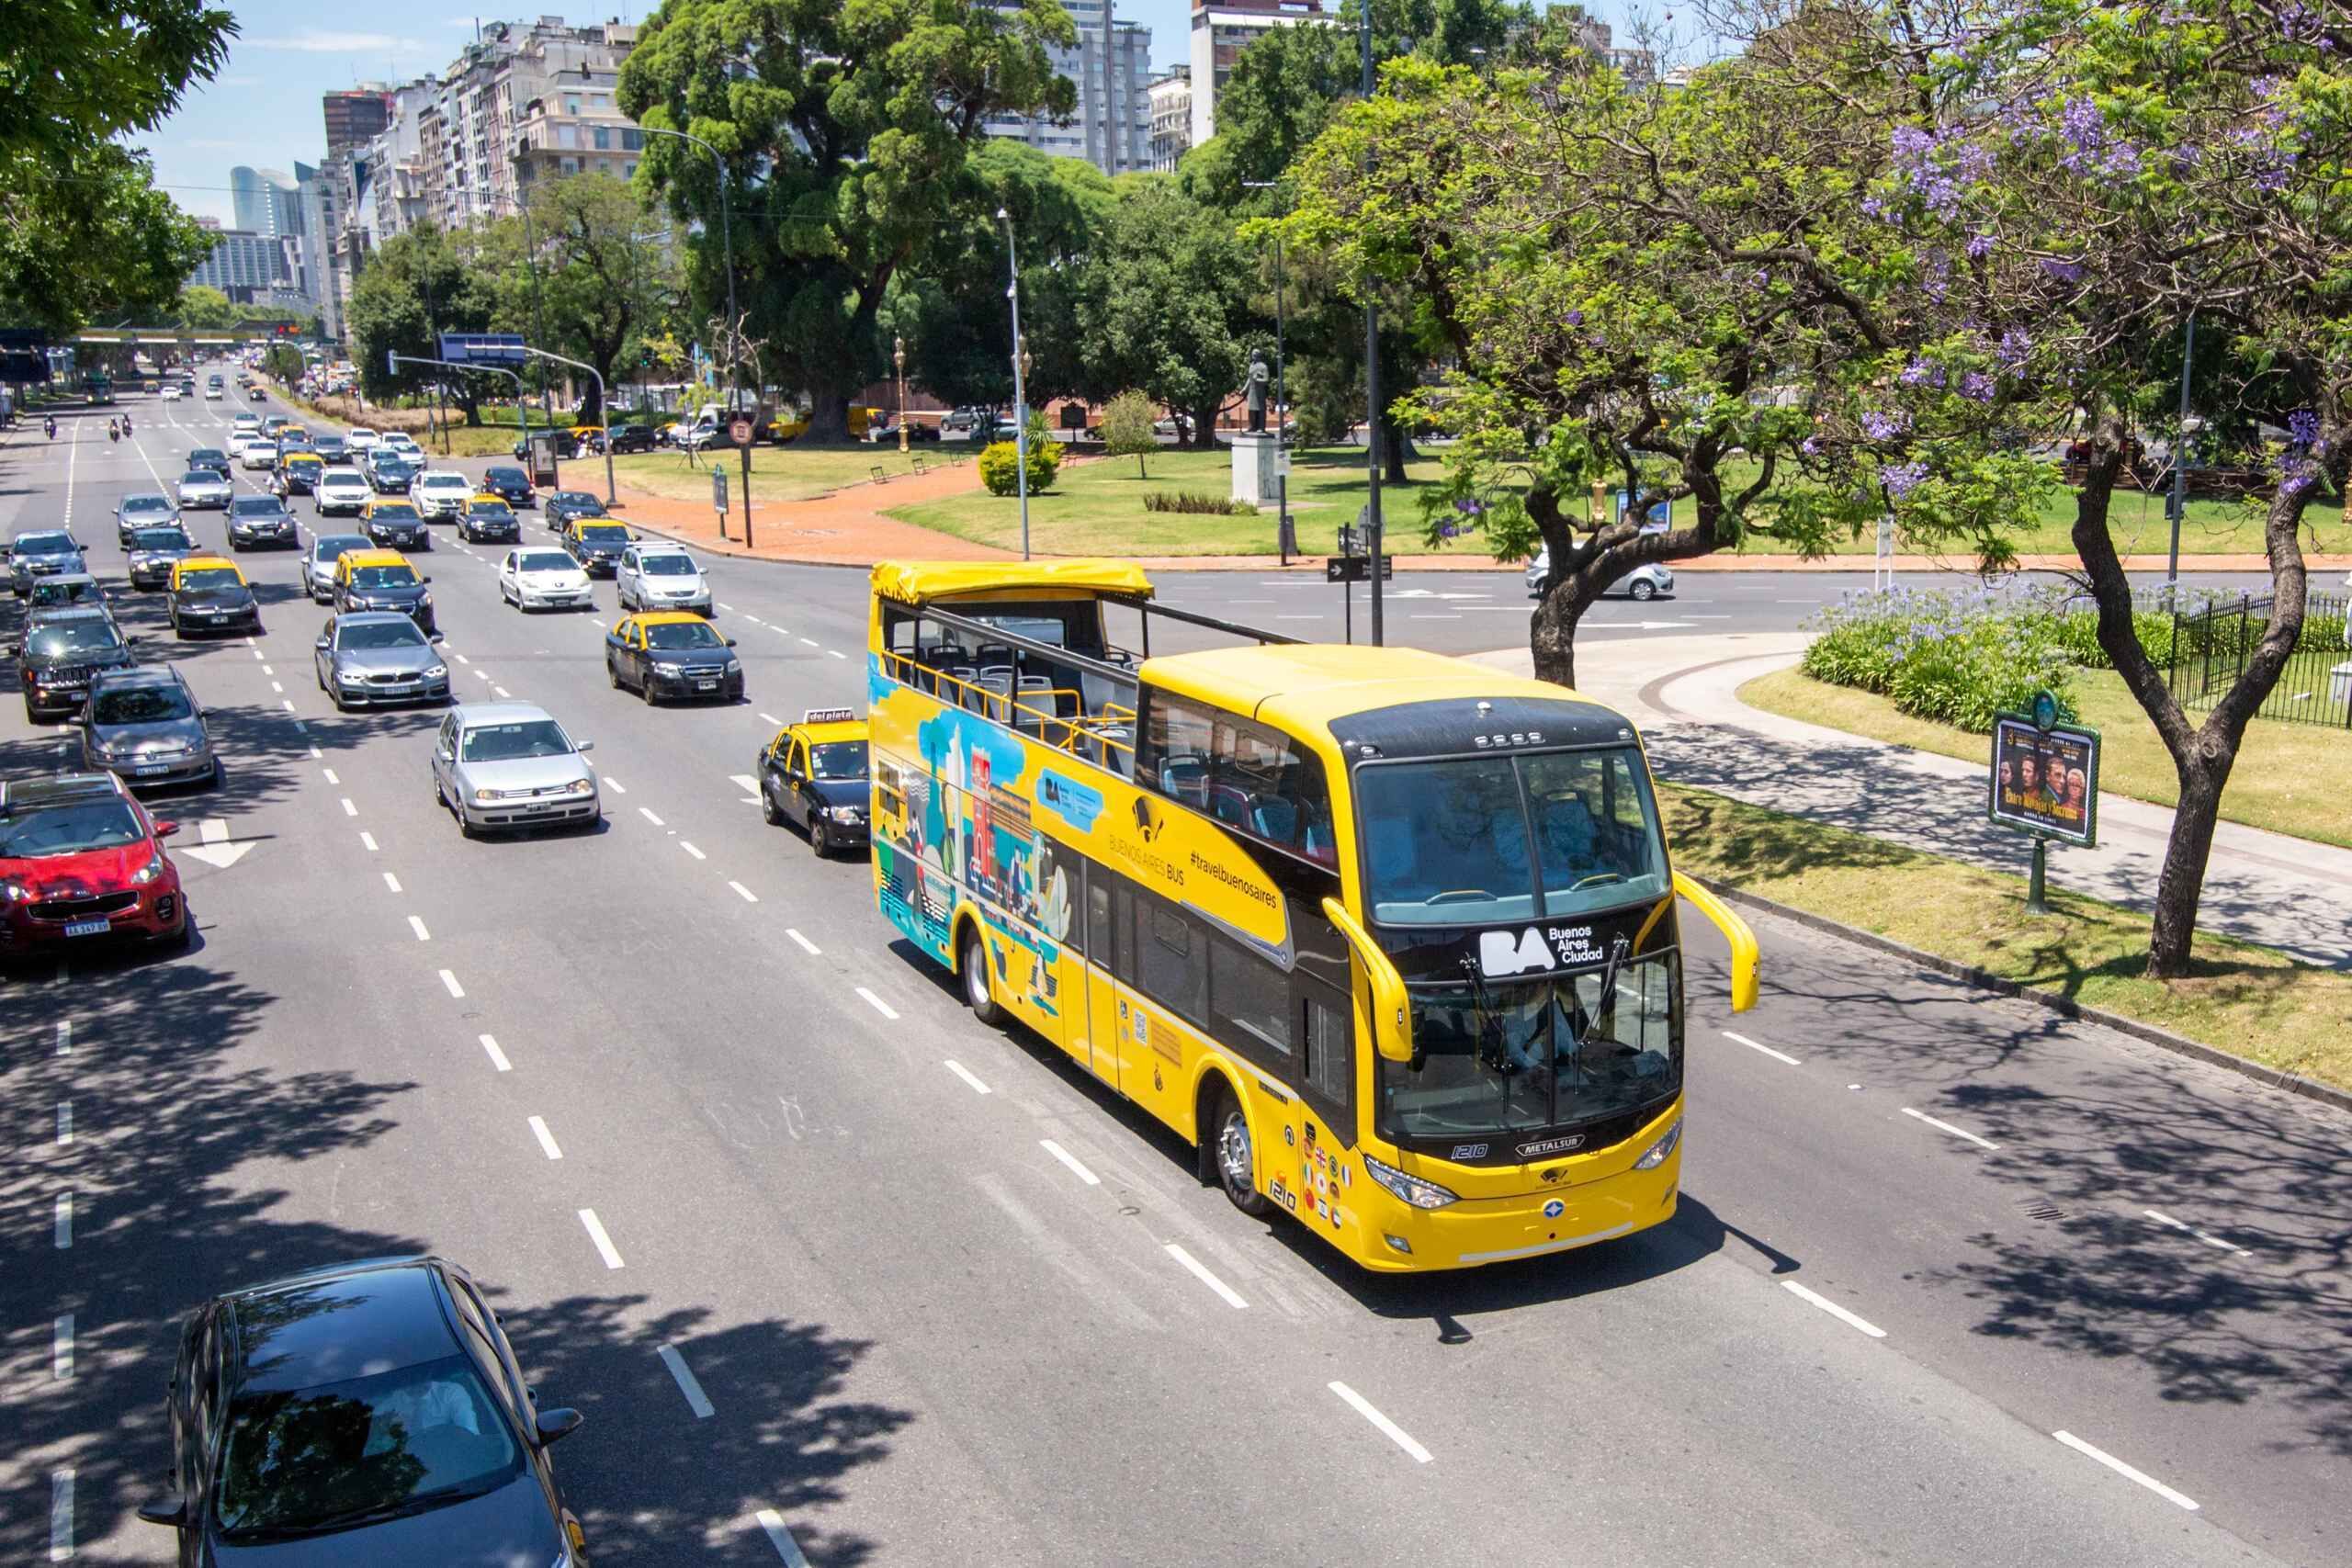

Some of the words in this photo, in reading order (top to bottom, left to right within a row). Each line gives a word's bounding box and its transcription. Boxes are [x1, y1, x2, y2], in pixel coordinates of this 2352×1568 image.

[826, 710, 852, 721] plata
[1109, 834, 1142, 865] BUENOS
[1142, 852, 1165, 877] AIRES
[1166, 863, 1184, 886] BUS
[1190, 850, 1278, 909] #travelbuenosaires
[1548, 926, 1592, 941] Buenos
[1479, 926, 1556, 977] BA
[1557, 939, 1589, 952] Aires
[1562, 946, 1603, 964] Ciudad
[1451, 1144, 1489, 1160] 1210
[1524, 1138, 1578, 1155] METALSUR
[1270, 1179, 1296, 1212] 1210
